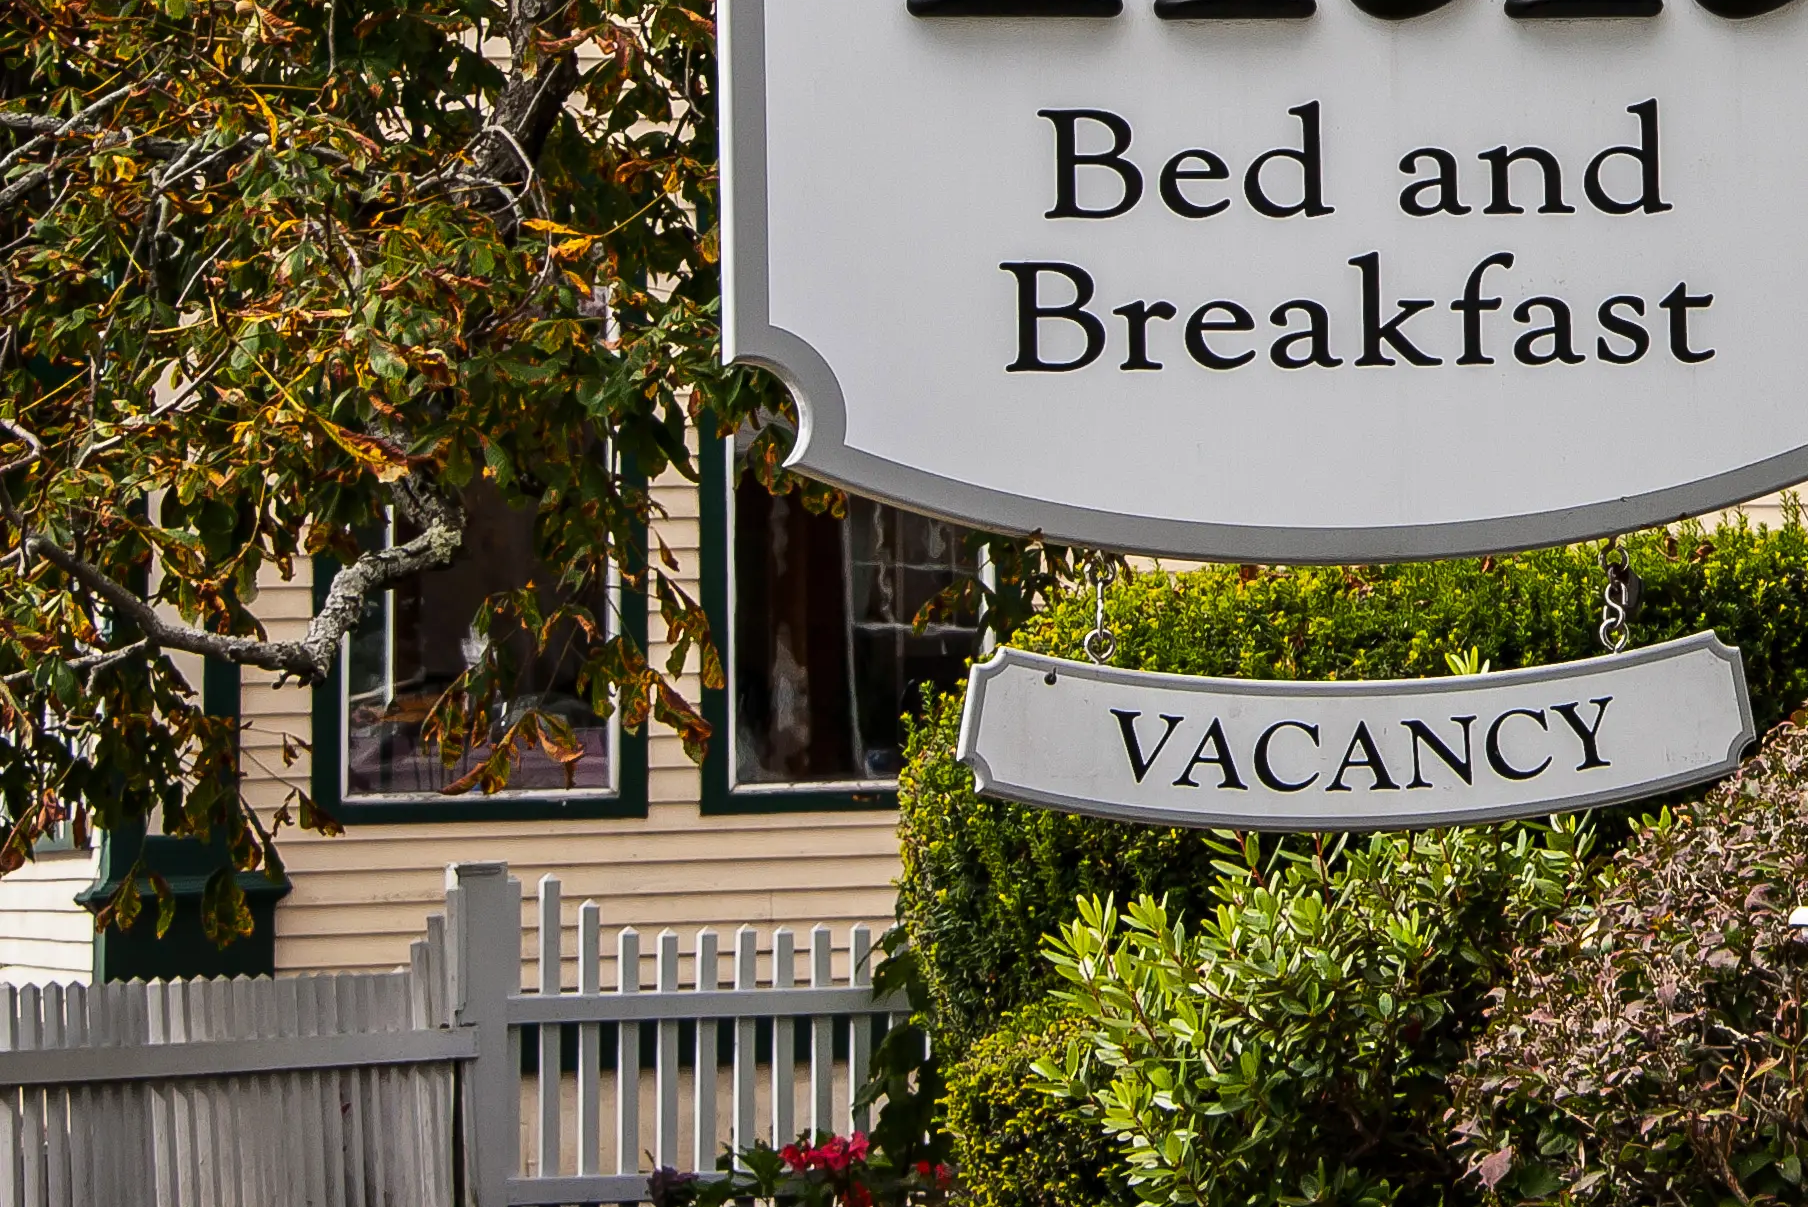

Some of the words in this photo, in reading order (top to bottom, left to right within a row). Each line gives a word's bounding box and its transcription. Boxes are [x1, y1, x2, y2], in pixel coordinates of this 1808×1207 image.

[1036, 99, 1335, 220] Bed
[1398, 97, 1674, 218] and
[998, 250, 1717, 374] Breakfast
[1108, 695, 1614, 794] VACANCY
